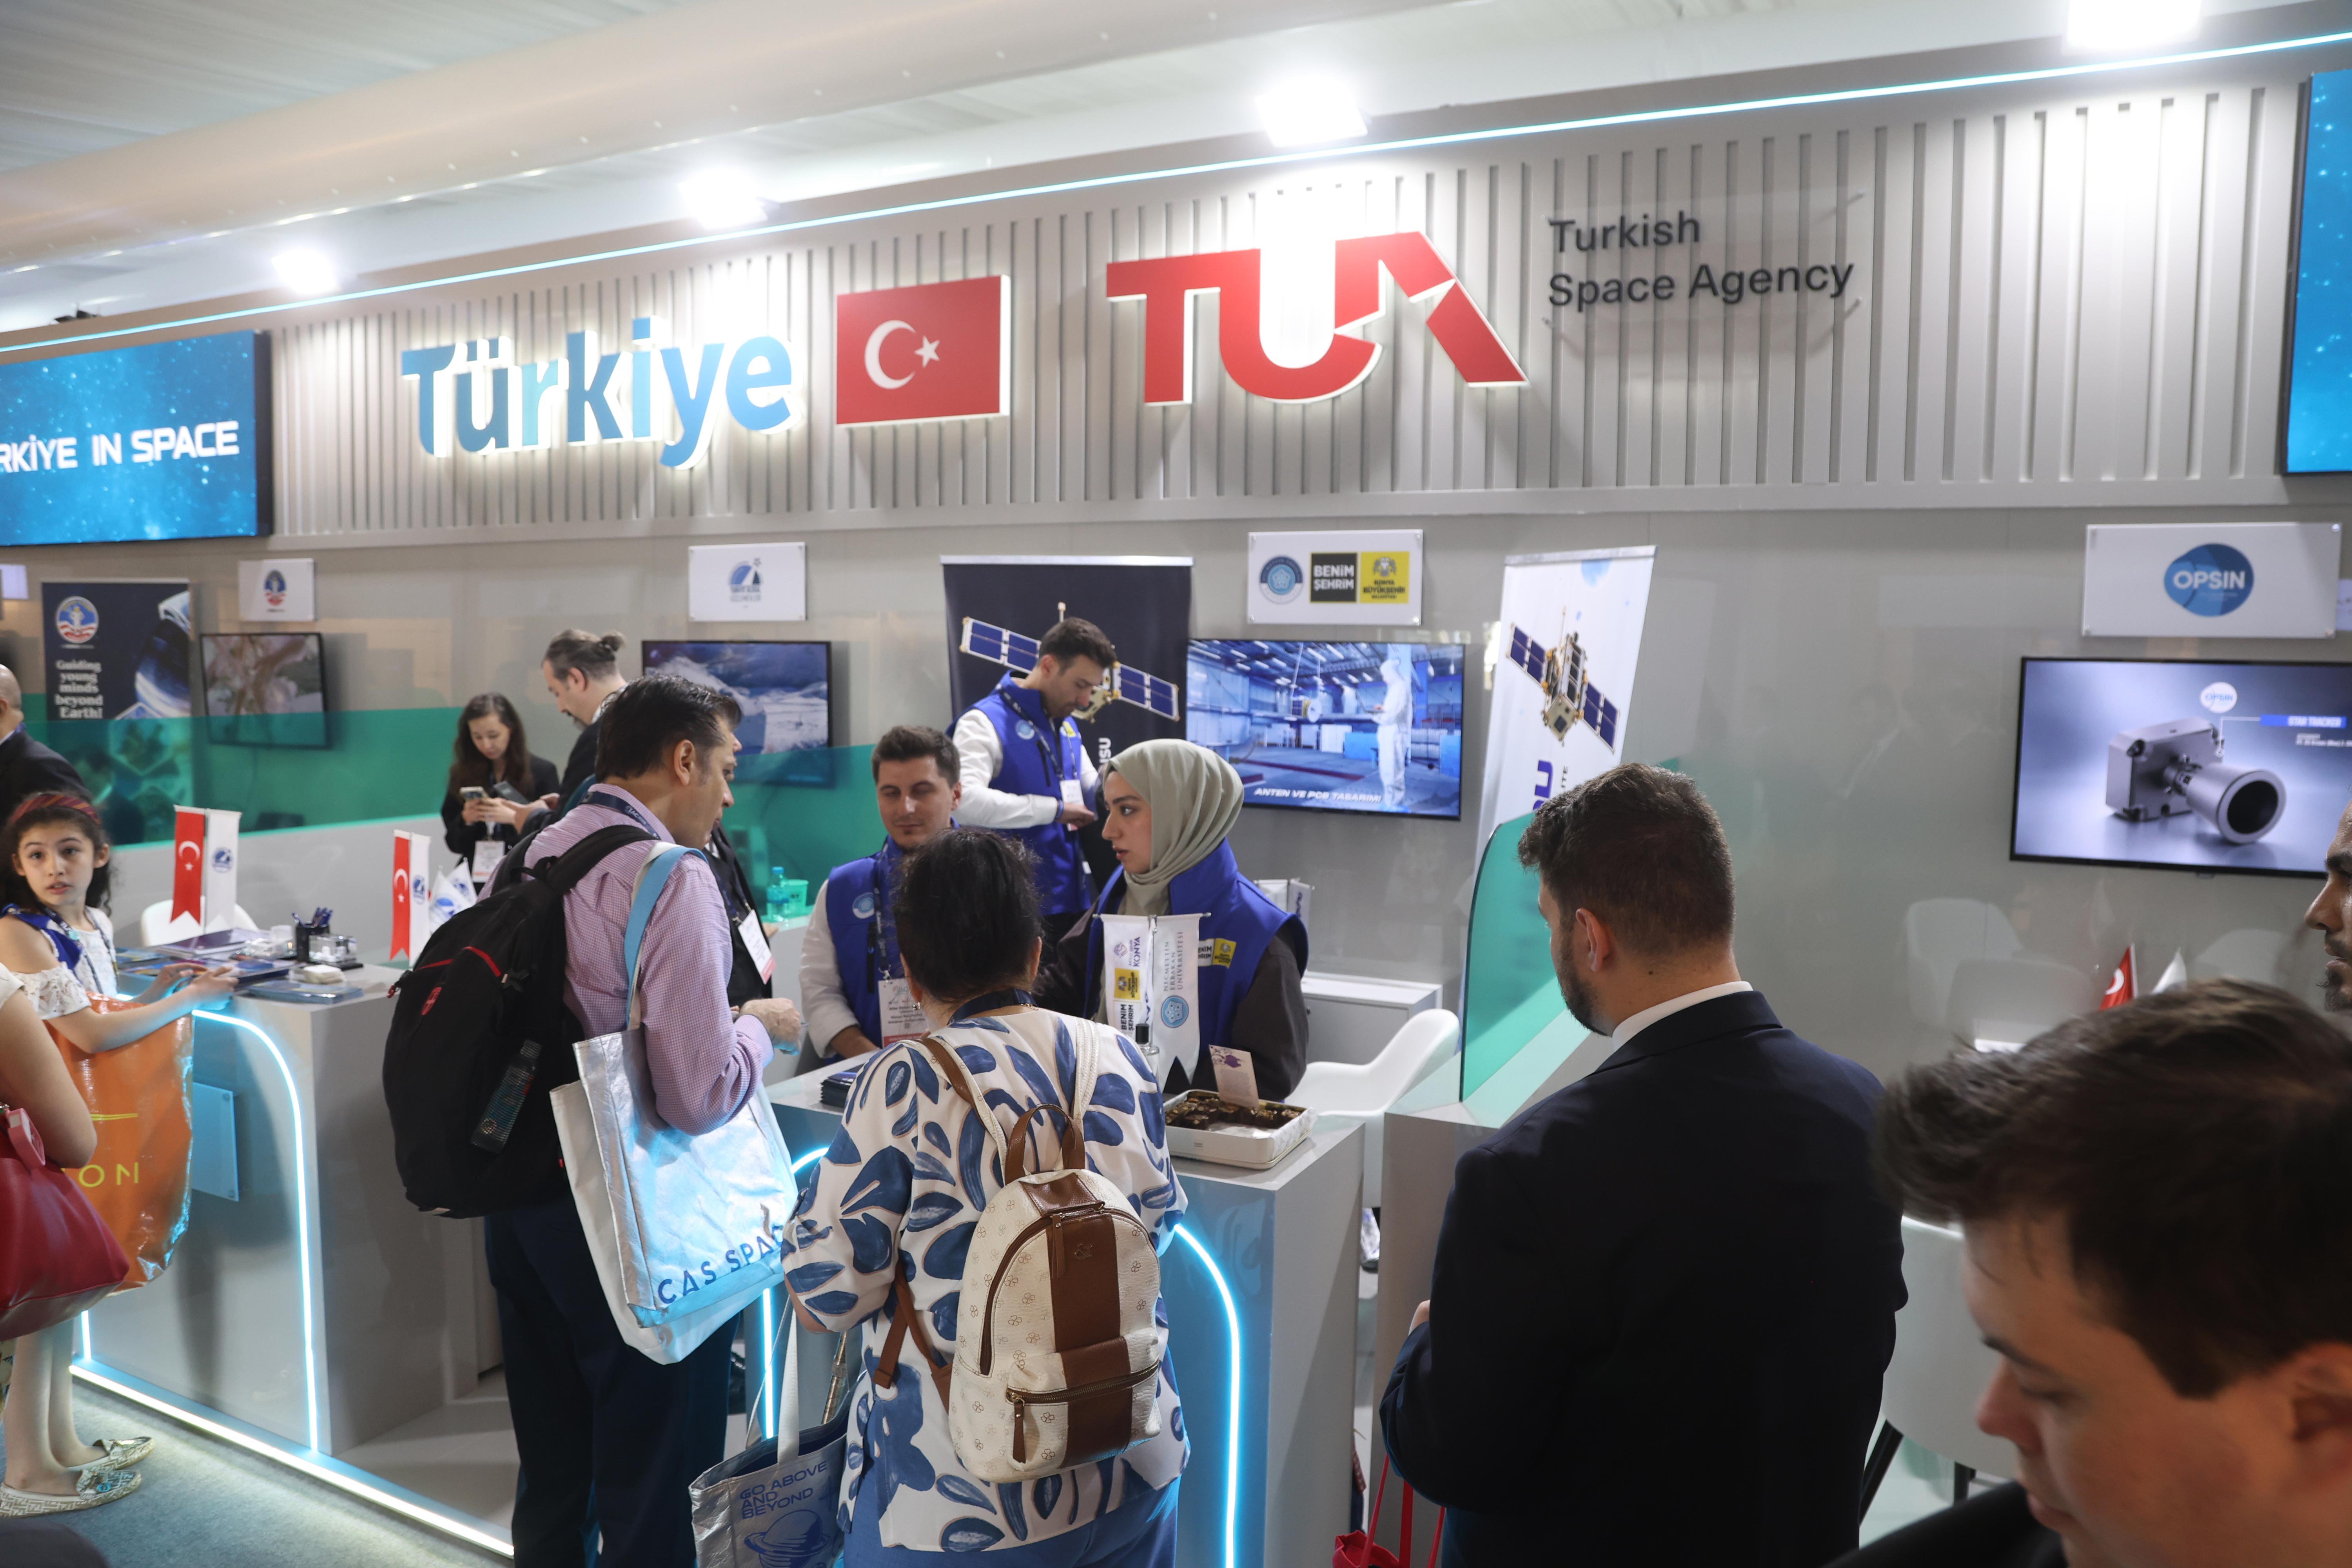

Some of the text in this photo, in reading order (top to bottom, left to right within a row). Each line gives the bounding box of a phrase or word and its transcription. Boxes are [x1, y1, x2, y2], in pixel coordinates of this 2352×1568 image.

[1549, 211, 1700, 252] Turkish
[1549, 263, 1855, 312] Space Agency
[1107, 231, 1528, 405] TUA
[401, 316, 797, 468] Türkiye
[0, 420, 240, 473] RKİYE IN SPACE
[1313, 564, 1355, 577] BENİM
[2173, 570, 2245, 590] OPSIN
[56, 659, 102, 673] Guiding
[60, 673, 98, 684] young
[60, 682, 99, 693] minds
[54, 693, 103, 708] beyond
[60, 706, 103, 719] Earth!
[1254, 788, 1291, 797] ANTEN
[1292, 789, 1307, 799] VE
[658, 1225, 783, 1304] CAS SPAC
[740, 1461, 828, 1499] GO ABOVE
[742, 1491, 778, 1510] AND
[742, 1488, 813, 1520] BEYOND
